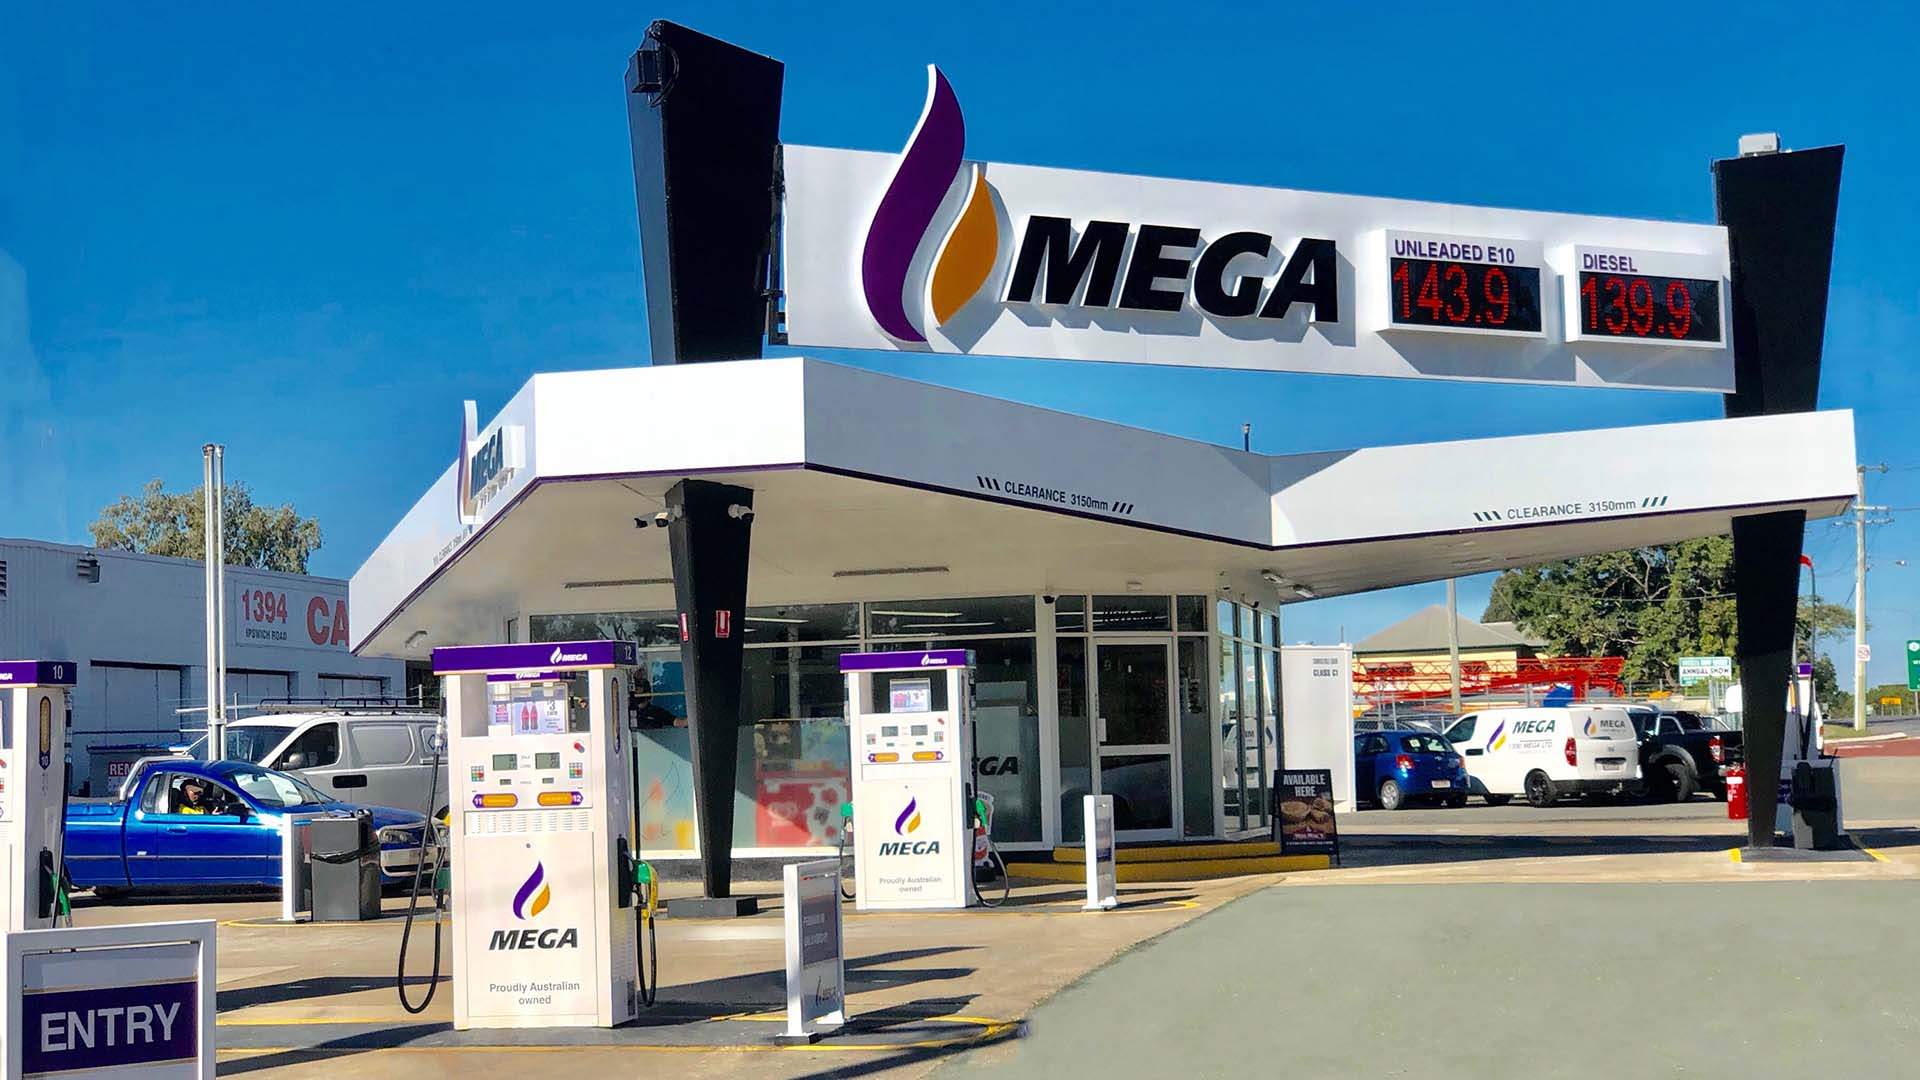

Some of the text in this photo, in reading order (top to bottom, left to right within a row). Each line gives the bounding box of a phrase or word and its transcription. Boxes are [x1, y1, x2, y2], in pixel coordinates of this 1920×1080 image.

[1394, 239, 1515, 264] UNLEADED E10
[1006, 215, 1339, 323] MEGA
[1583, 253, 1638, 272] DIESEL
[1393, 261, 1510, 324] 143.9
[1581, 276, 1692, 339] 139.9
[1004, 481, 1108, 511] CLEARANCE 3150mm
[1507, 499, 1637, 520] CLEARANCE 3150mm
[242, 589, 288, 625] 1394
[245, 627, 287, 641] IPSWICH ROAD
[562, 653, 588, 662] MEGA
[624, 644, 632, 660] 12
[52, 664, 64, 680] 10
[1511, 719, 1556, 734] MEGA
[1600, 719, 1626, 728] MEGA
[1283, 774, 1326, 786] AVAILABLE
[1294, 785, 1317, 797] HERE
[879, 841, 941, 857] MEGA
[879, 875, 943, 885] Proudly Australian
[898, 886, 923, 894] owned
[488, 928, 578, 951] MEGA
[489, 981, 580, 994] Proudly Australian
[518, 995, 552, 1005] owned
[40, 1002, 181, 1053] ENTRY
